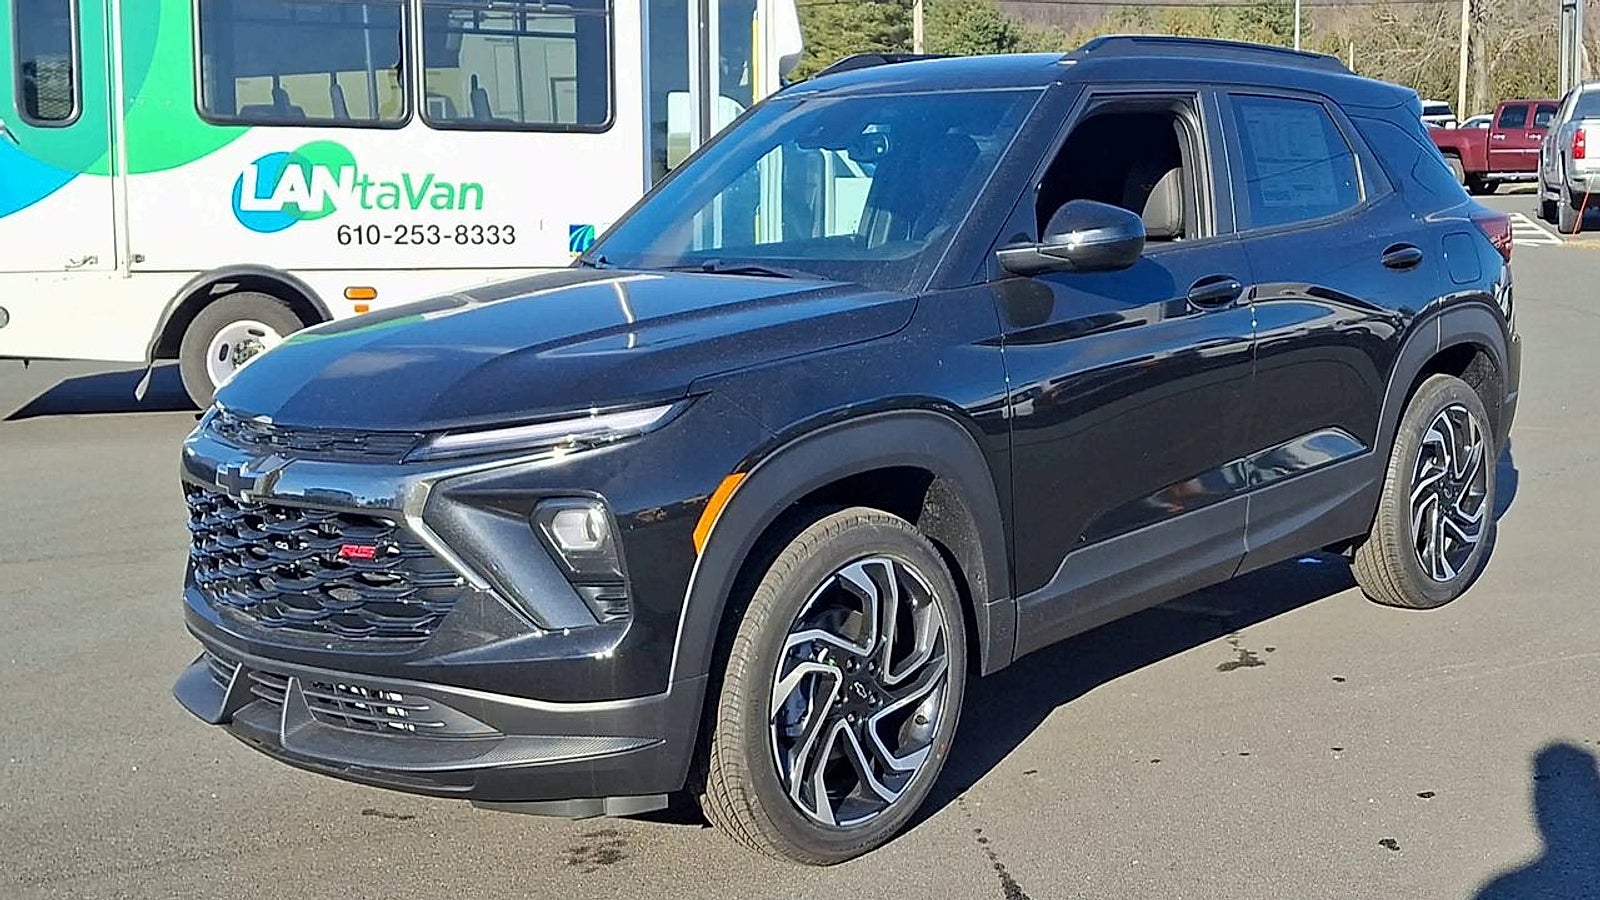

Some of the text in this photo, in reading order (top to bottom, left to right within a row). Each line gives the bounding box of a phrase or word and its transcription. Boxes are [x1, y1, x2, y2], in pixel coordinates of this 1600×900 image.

[239, 163, 484, 212] LANtaVan
[336, 225, 517, 246] 610-253-8333
[338, 544, 376, 559] RS
